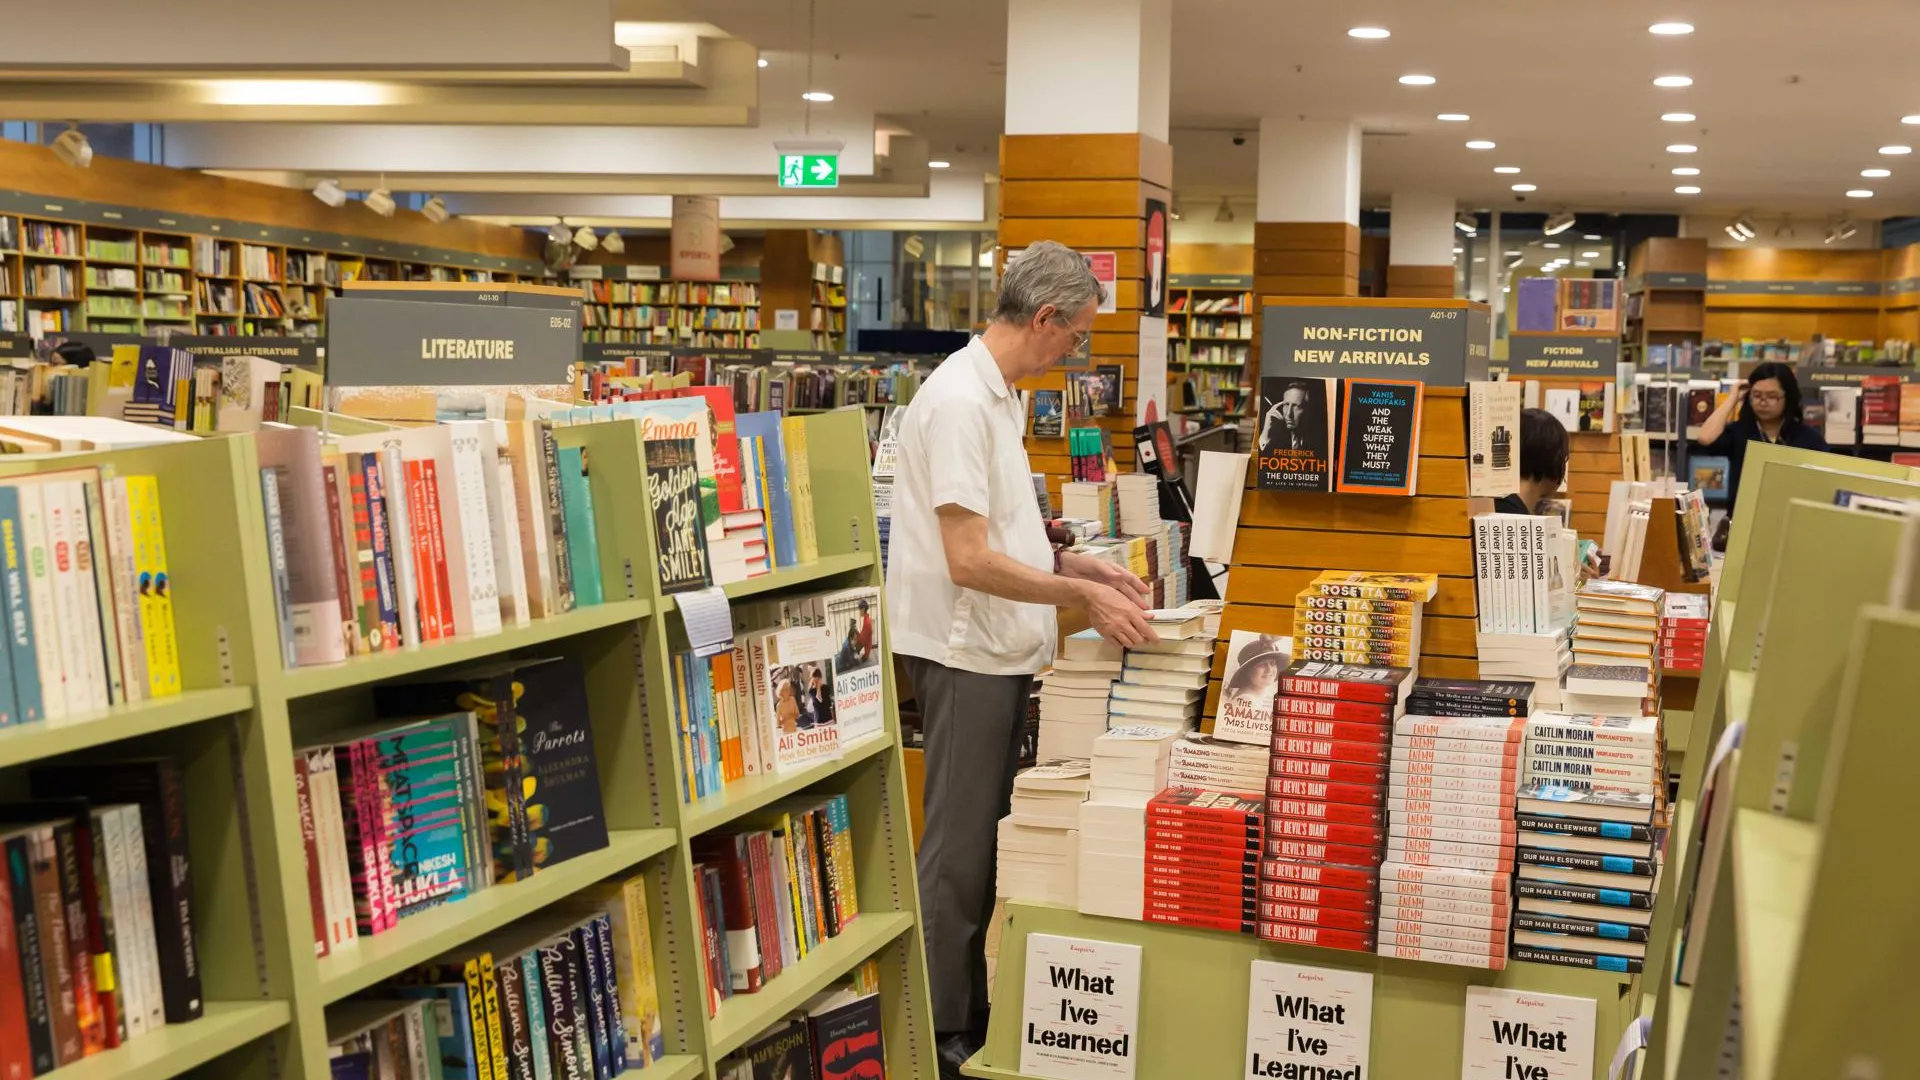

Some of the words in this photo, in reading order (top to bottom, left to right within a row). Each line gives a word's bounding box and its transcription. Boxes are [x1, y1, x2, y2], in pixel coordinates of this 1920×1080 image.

[1430, 311, 1458, 320] A01-07
[1303, 326, 1422, 342] NON-FICTION
[244, 348, 299, 356] LITERATURE
[421, 338, 514, 360] LITERATURE
[1544, 346, 1584, 355] FICTION
[1294, 350, 1334, 364] NEW
[1339, 351, 1430, 366] ARRIVALS
[1526, 360, 1548, 368] NEW
[1550, 360, 1600, 369] ARRIVALS
[1358, 397, 1406, 406] VAROUFAKIS
[1372, 390, 1394, 398] YANIS
[1372, 408, 1391, 416] AND
[641, 417, 699, 440] Emma
[1372, 417, 1389, 425] THE
[1367, 426, 1393, 434] WEAK
[1362, 434, 1395, 443] SUFFER
[1273, 448, 1315, 457] FREDERICK
[1366, 443, 1392, 452] WHAT
[1366, 452, 1388, 460] THEY
[1259, 457, 1327, 473] FORSYTH
[1362, 461, 1391, 470] MUST?
[1266, 472, 1281, 480] THE
[1283, 473, 1320, 482] OUTSIDER
[648, 466, 698, 510] Golden
[1479, 526, 1488, 551] oliver
[1493, 526, 1502, 551] oliver
[1506, 526, 1515, 551] oliver
[1520, 526, 1528, 551] oliver
[1536, 526, 1544, 551] oliver
[660, 550, 706, 582] SMILEY
[1478, 552, 1488, 580] james
[1492, 552, 1502, 580] james
[1506, 552, 1516, 580] james
[1520, 552, 1530, 580] james
[1535, 552, 1545, 580] james
[1321, 584, 1384, 598] ROSETTA
[1307, 597, 1369, 610] ROSETTA
[1306, 610, 1368, 624] ROSETTA
[1305, 624, 1366, 638] ROSETTA
[1304, 636, 1366, 650] ROSETTA
[734, 647, 744, 661] Ali
[752, 646, 762, 661] Ali
[1303, 650, 1365, 663] ROSETTA
[736, 665, 748, 698] Smith
[754, 664, 766, 696] Smith
[836, 680, 848, 696] Ali
[850, 670, 880, 692] Smith
[1282, 678, 1293, 691] THE
[1295, 679, 1318, 694] DEVIL'S
[1320, 680, 1339, 695] DIARY
[837, 697, 857, 711] Public
[858, 690, 880, 706] library
[1278, 699, 1289, 711] THE
[1290, 700, 1314, 714] DEVIL'S
[1316, 701, 1335, 715] DIARY
[1224, 717, 1245, 728] MRS
[1414, 724, 1439, 736] ENEMY
[532, 730, 585, 754] Parrots
[778, 735, 794, 752] Ali
[797, 727, 838, 747] Smith
[1534, 726, 1564, 739] CAITLIN
[1566, 728, 1594, 741] MORAN
[1596, 734, 1633, 742] MORANIFESTO
[1183, 747, 1210, 756] AMAZING
[1275, 739, 1286, 752] THE
[1288, 740, 1311, 754] DEVIL'S
[1313, 741, 1332, 755] DIARY
[1534, 744, 1564, 756] CAITLIN
[1566, 746, 1594, 758] MORAN
[1596, 751, 1633, 759] MORANIFESTO
[1182, 760, 1208, 768] AMAZING
[1533, 760, 1562, 773] CAITLIN
[1564, 762, 1592, 776] MORAN
[1594, 768, 1631, 776] MORANIFESTO
[1407, 775, 1432, 787] ENEMY
[1407, 826, 1432, 838] ENEMY
[1555, 823, 1597, 833] ELSEWHERE
[1557, 856, 1599, 866] ELSEWHERE
[1264, 862, 1275, 876] THE
[1276, 864, 1300, 878] DEVIL'S
[1302, 866, 1321, 880] DIARY
[1397, 868, 1424, 881] ENEMY
[1400, 896, 1424, 908] ENEMY
[1554, 890, 1596, 899] ELSEWHERE
[1261, 922, 1272, 938] THE
[1274, 924, 1296, 940] DEVIL'S
[1298, 927, 1318, 942] DIARY
[1396, 921, 1421, 934] ENEMY
[1551, 955, 1593, 965] ELSEWHERE
[1050, 966, 1114, 996] What
[1060, 998, 1098, 1026] I've
[1276, 994, 1345, 1025] What
[775, 1032, 804, 1056] SOHN
[1028, 1022, 1129, 1057] Learned
[1288, 1028, 1328, 1056] I've
[1492, 1020, 1567, 1052] What
[1252, 1052, 1361, 1080] Learned
[1506, 1056, 1548, 1080] I've
